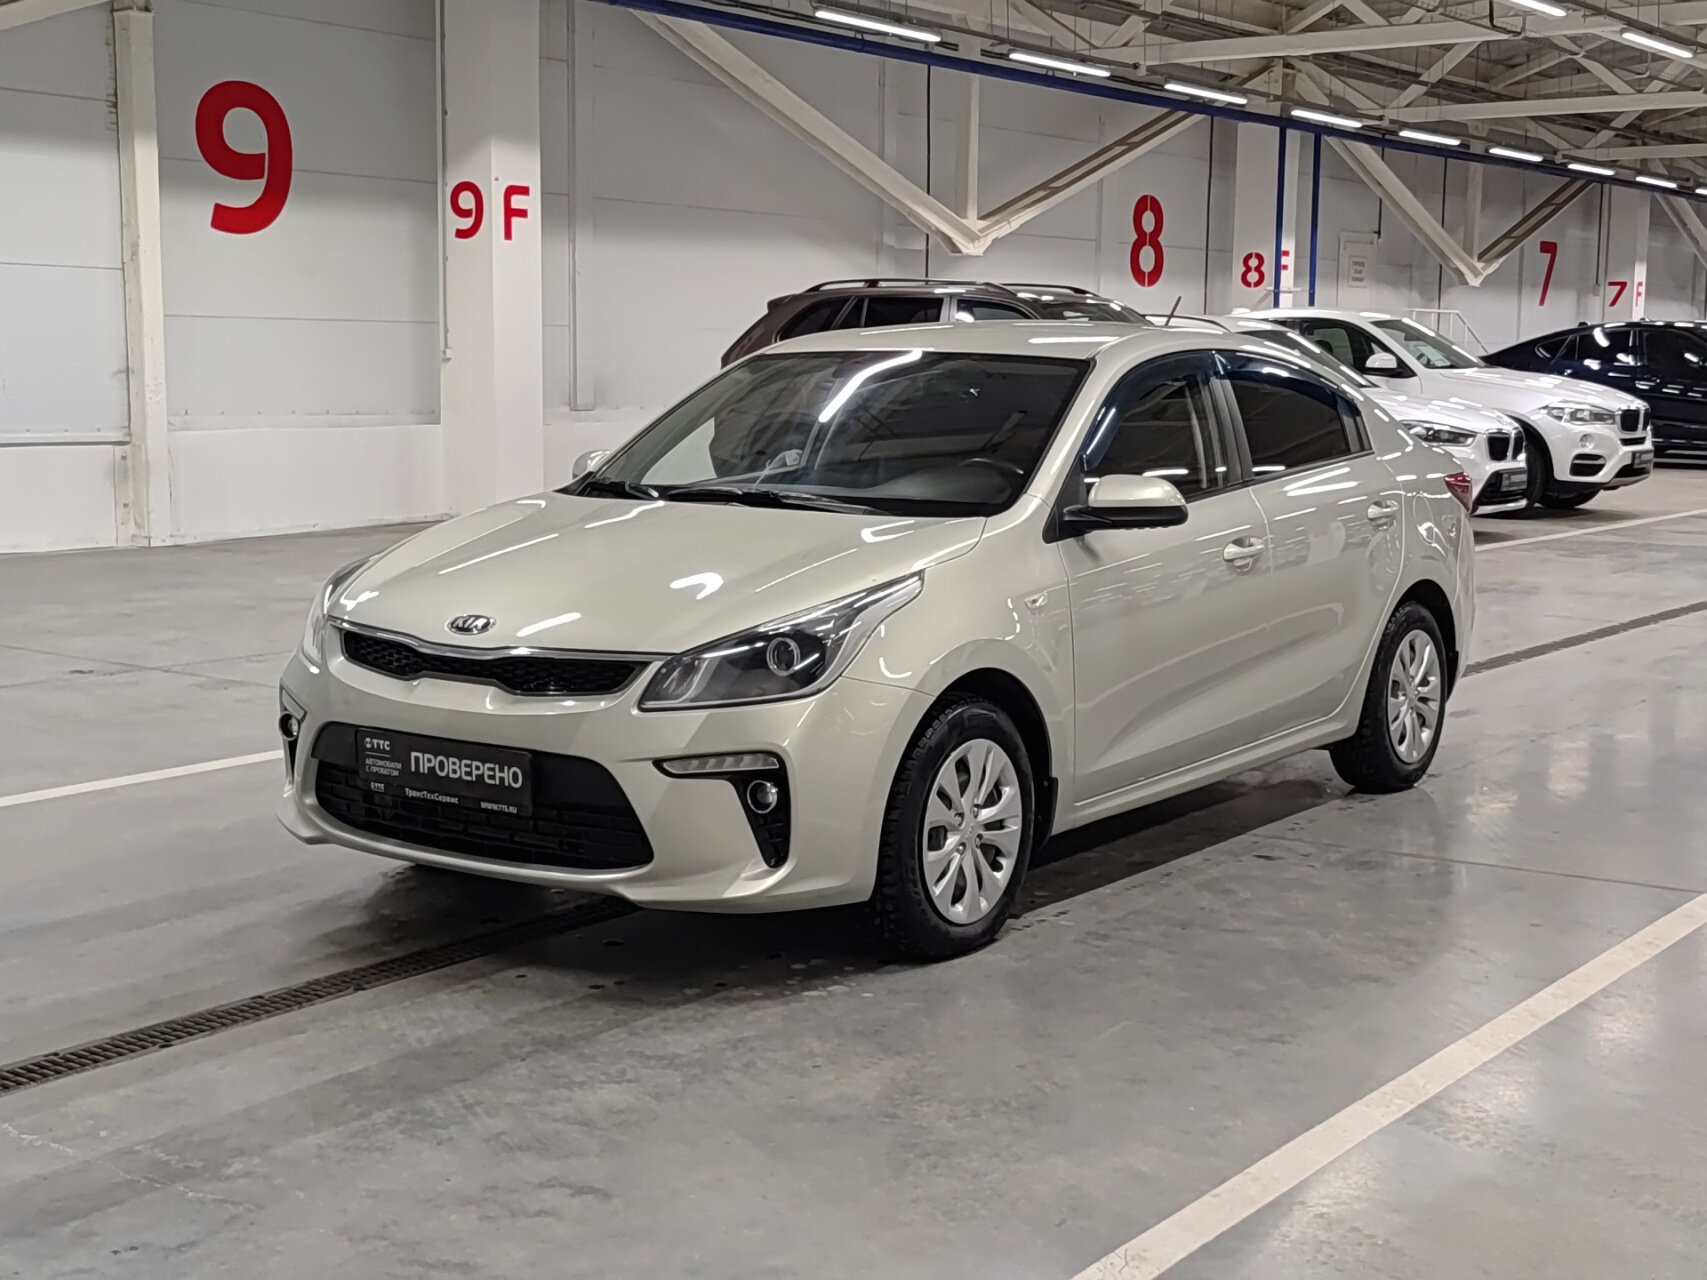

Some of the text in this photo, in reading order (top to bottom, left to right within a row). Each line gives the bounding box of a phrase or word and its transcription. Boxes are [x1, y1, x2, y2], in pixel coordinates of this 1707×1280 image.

[195, 80, 293, 234] 9
[1130, 194, 1164, 287] 8
[1538, 241, 1558, 306] 7
[453, 616, 488, 630] KIA
[410, 751, 523, 788] ПРОВЕРЕНО
